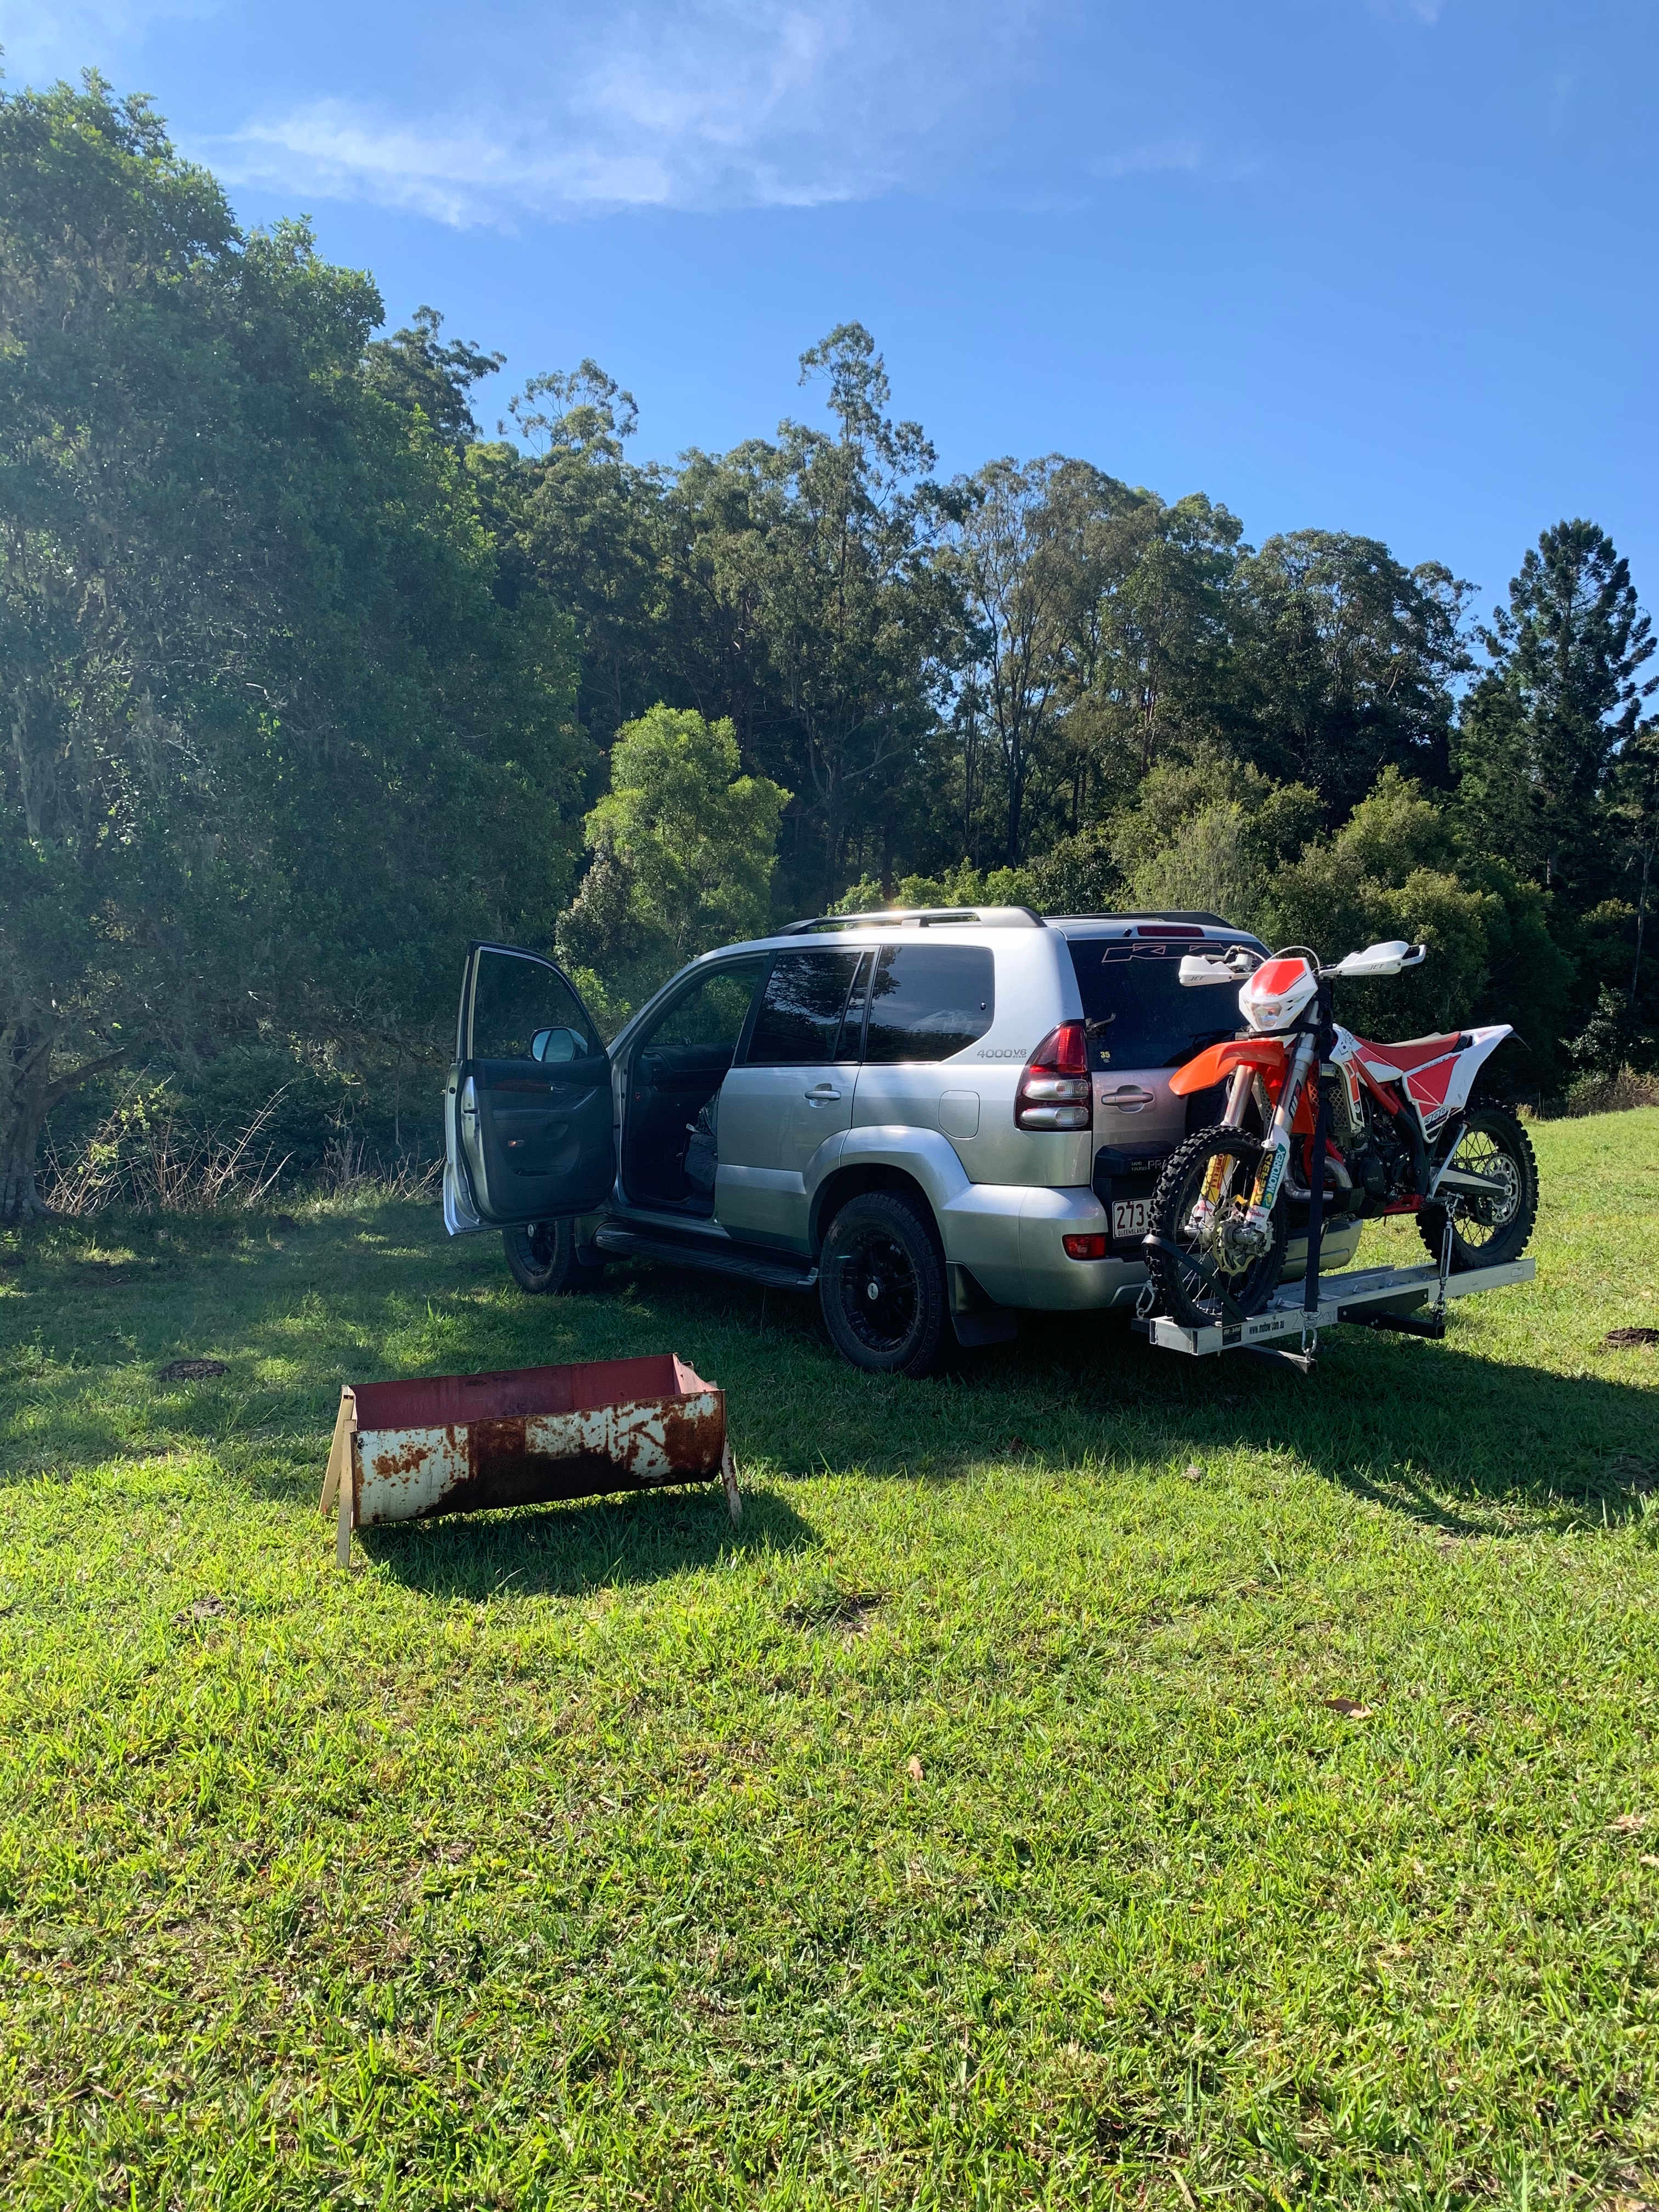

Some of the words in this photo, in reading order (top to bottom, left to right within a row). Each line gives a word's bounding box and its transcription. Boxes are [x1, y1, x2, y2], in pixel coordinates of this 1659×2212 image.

[977, 1049, 1013, 1058] 4000
[1255, 1153, 1273, 1205] ACERBIS
[1266, 1149, 1286, 1194] MOTOREX
[1117, 1203, 1144, 1229] 273
[1118, 1227, 1146, 1235] QUEENSLAND
